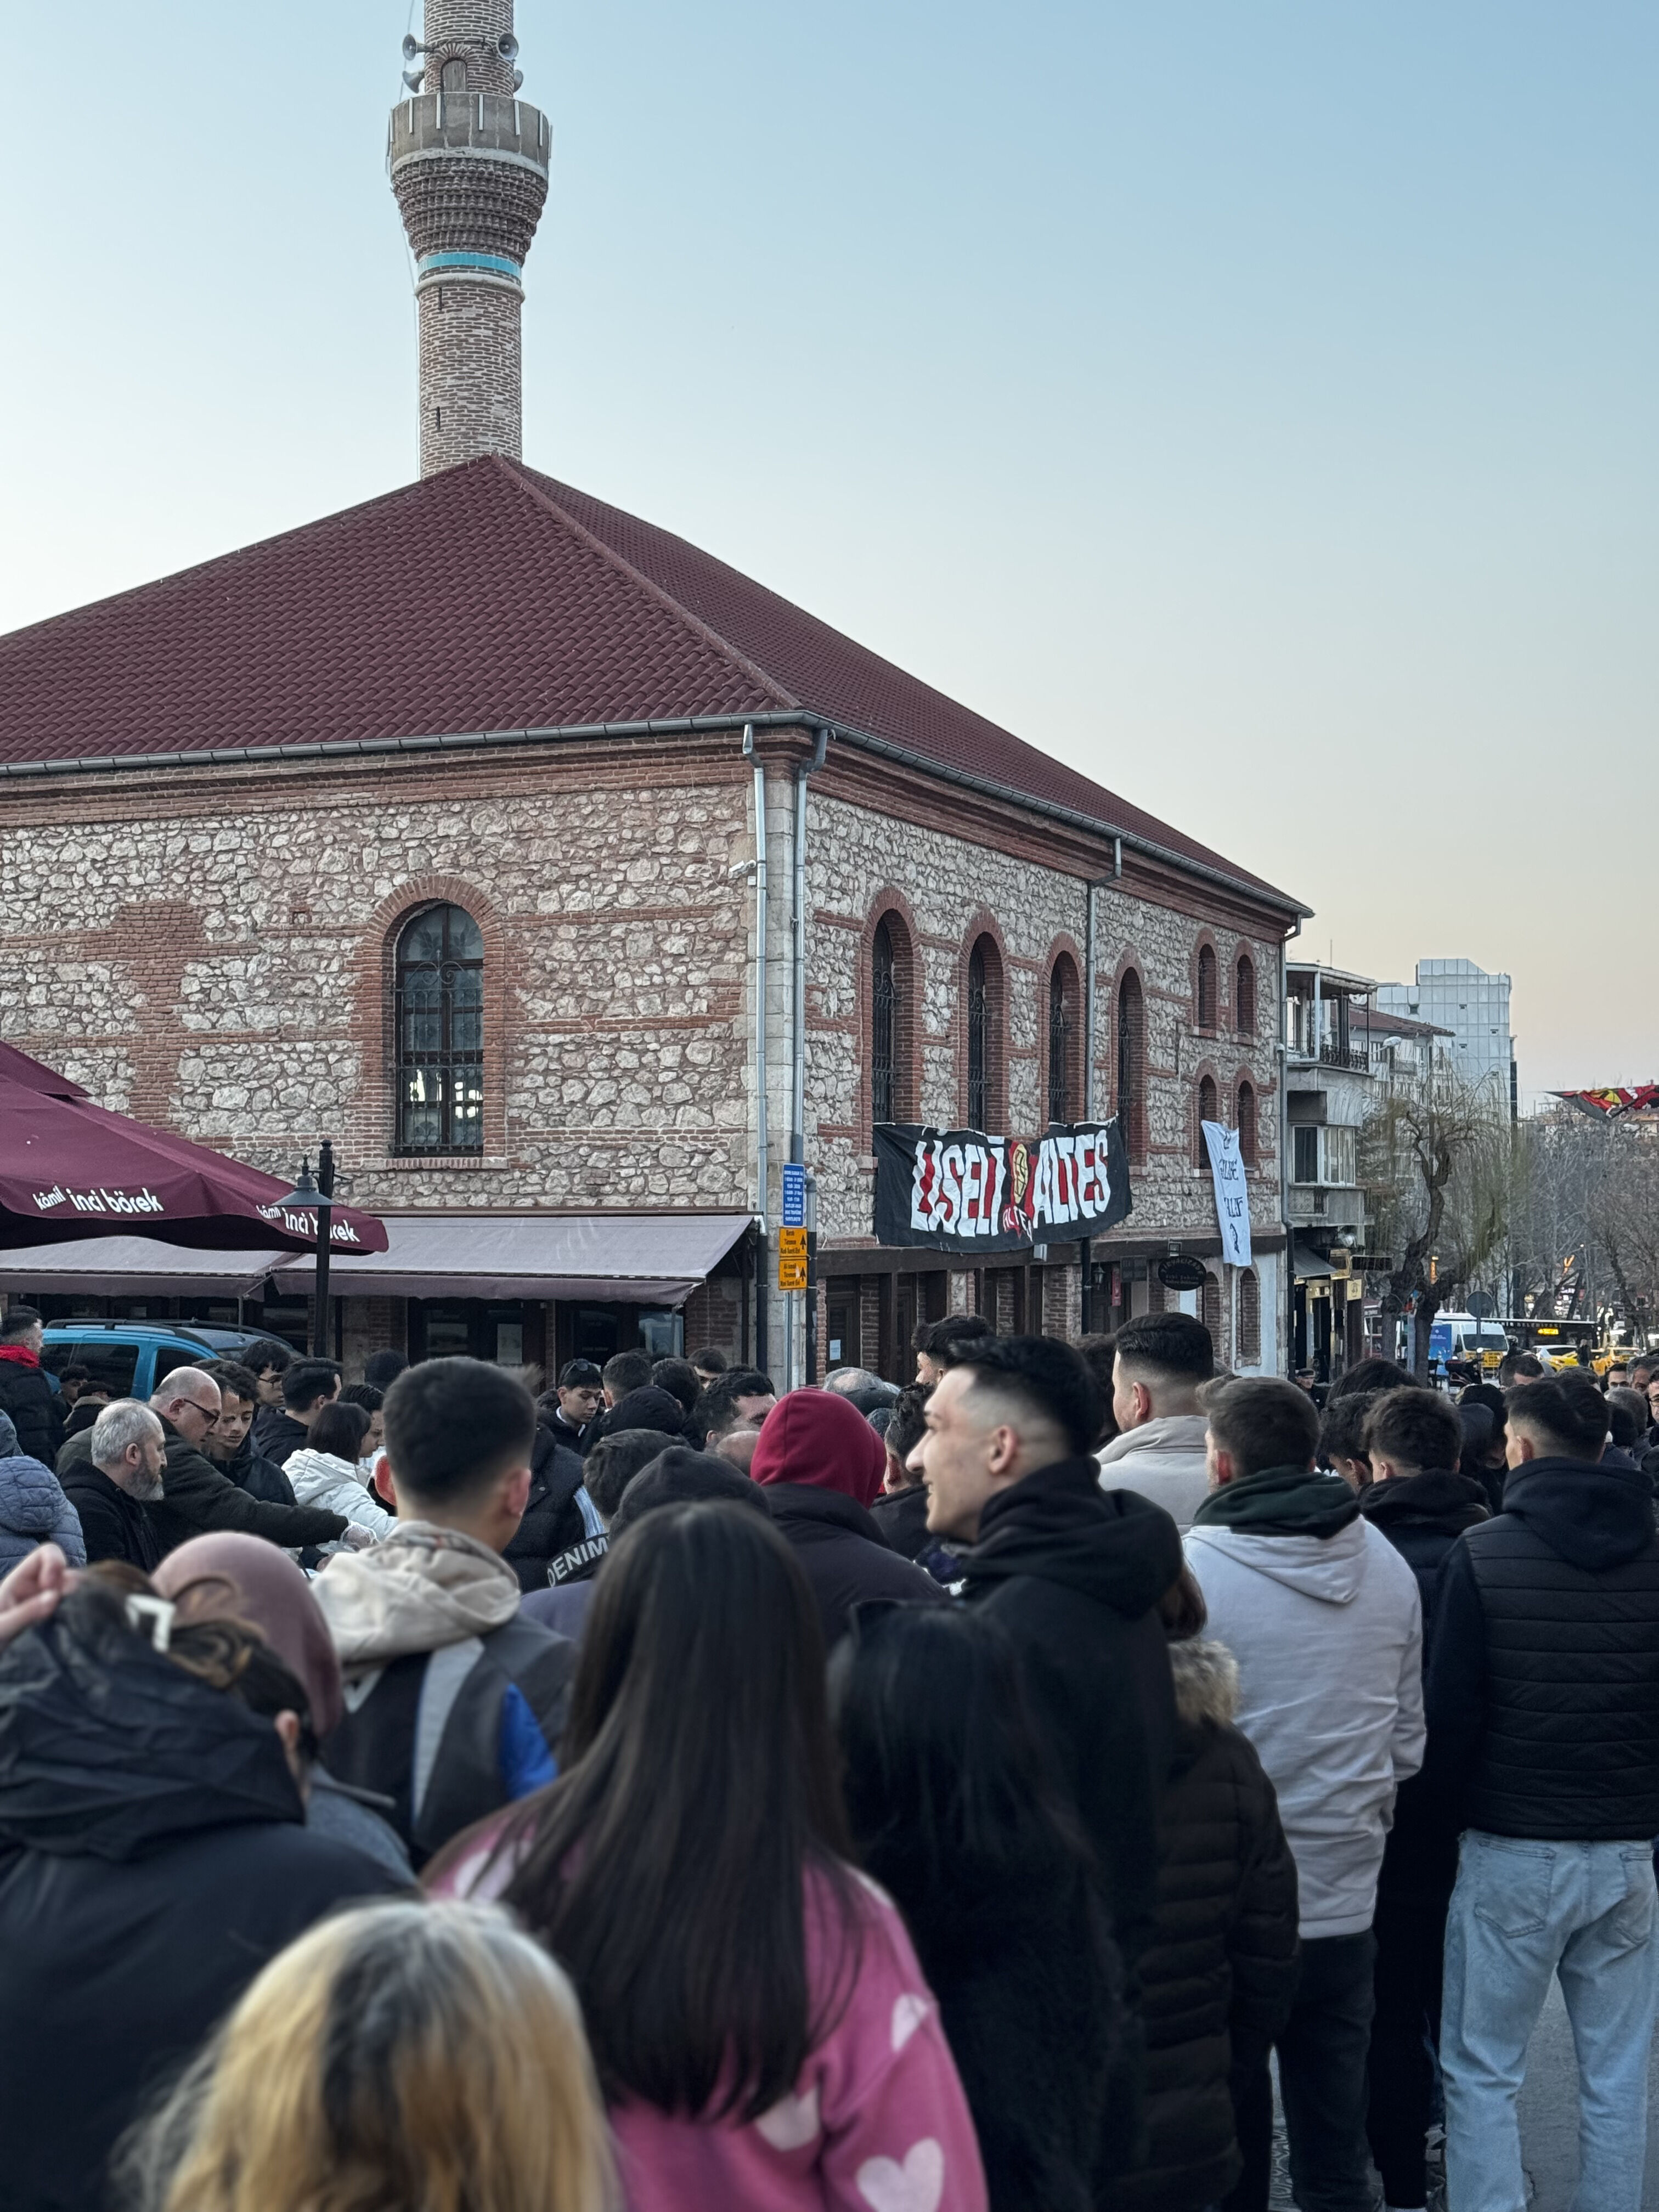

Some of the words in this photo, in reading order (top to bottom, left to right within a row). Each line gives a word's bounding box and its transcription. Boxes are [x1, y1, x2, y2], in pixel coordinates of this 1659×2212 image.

[66, 1188, 106, 1212] inci
[99, 1187, 164, 1214] börek
[309, 1212, 361, 1243] brek
[546, 1536, 611, 1588] DENIM
